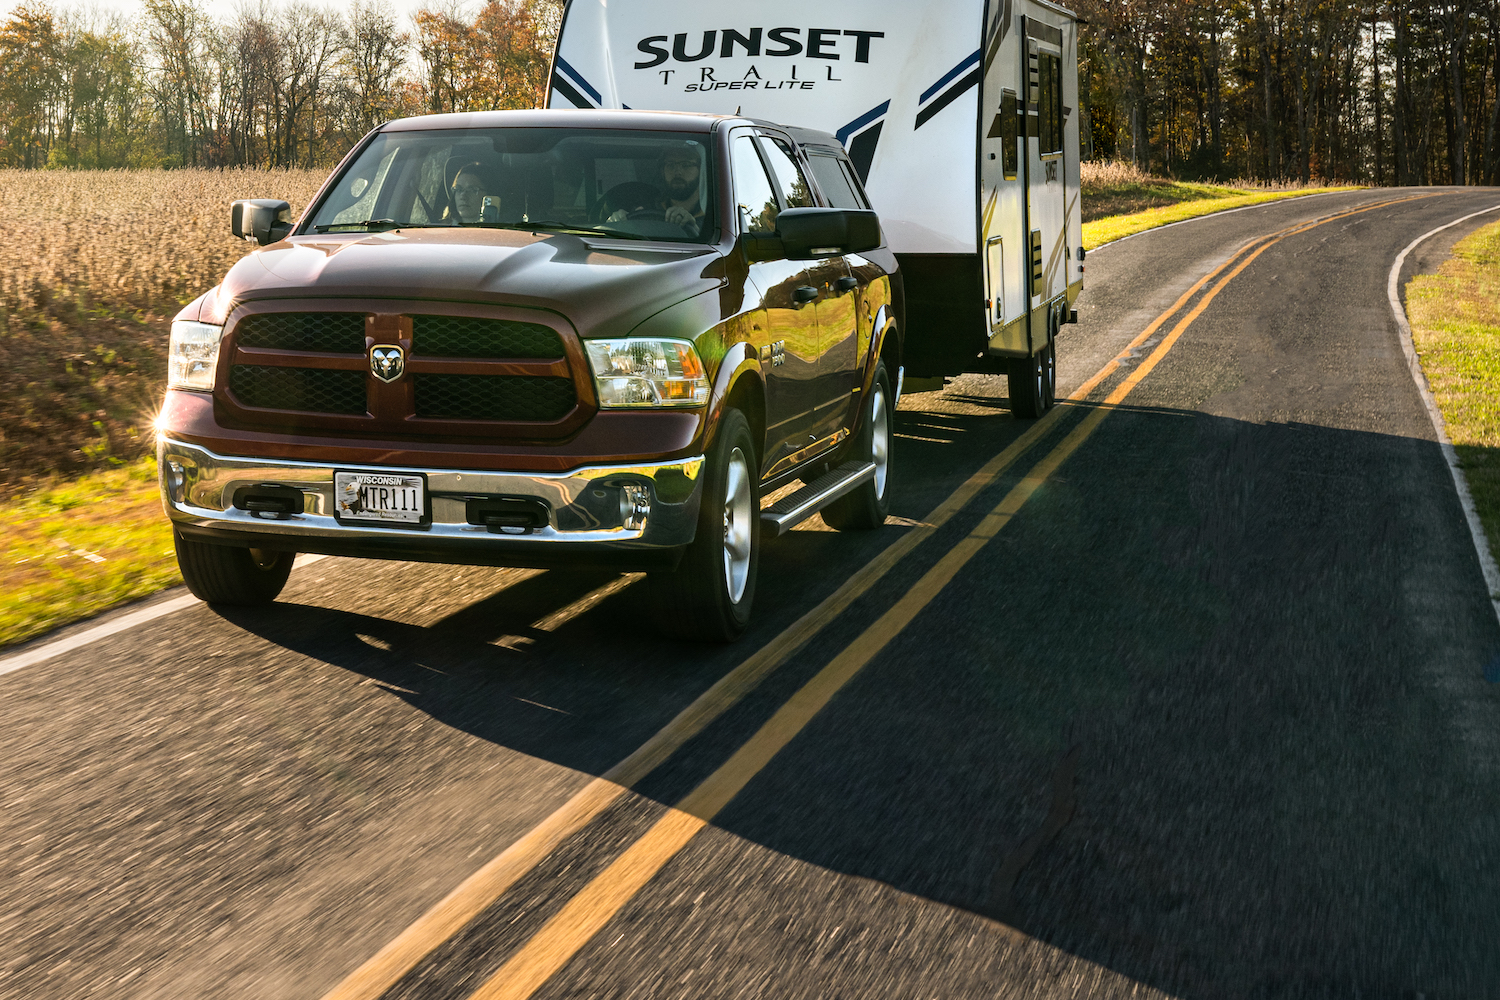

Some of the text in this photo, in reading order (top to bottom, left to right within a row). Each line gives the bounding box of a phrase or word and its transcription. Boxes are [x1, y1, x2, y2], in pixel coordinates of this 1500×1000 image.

[633, 27, 885, 69] SUNSET
[658, 64, 842, 85] TRAIL
[684, 80, 816, 92] SUPER LITE
[356, 475, 402, 486] WISCONSIN
[359, 486, 418, 511] MTR111
